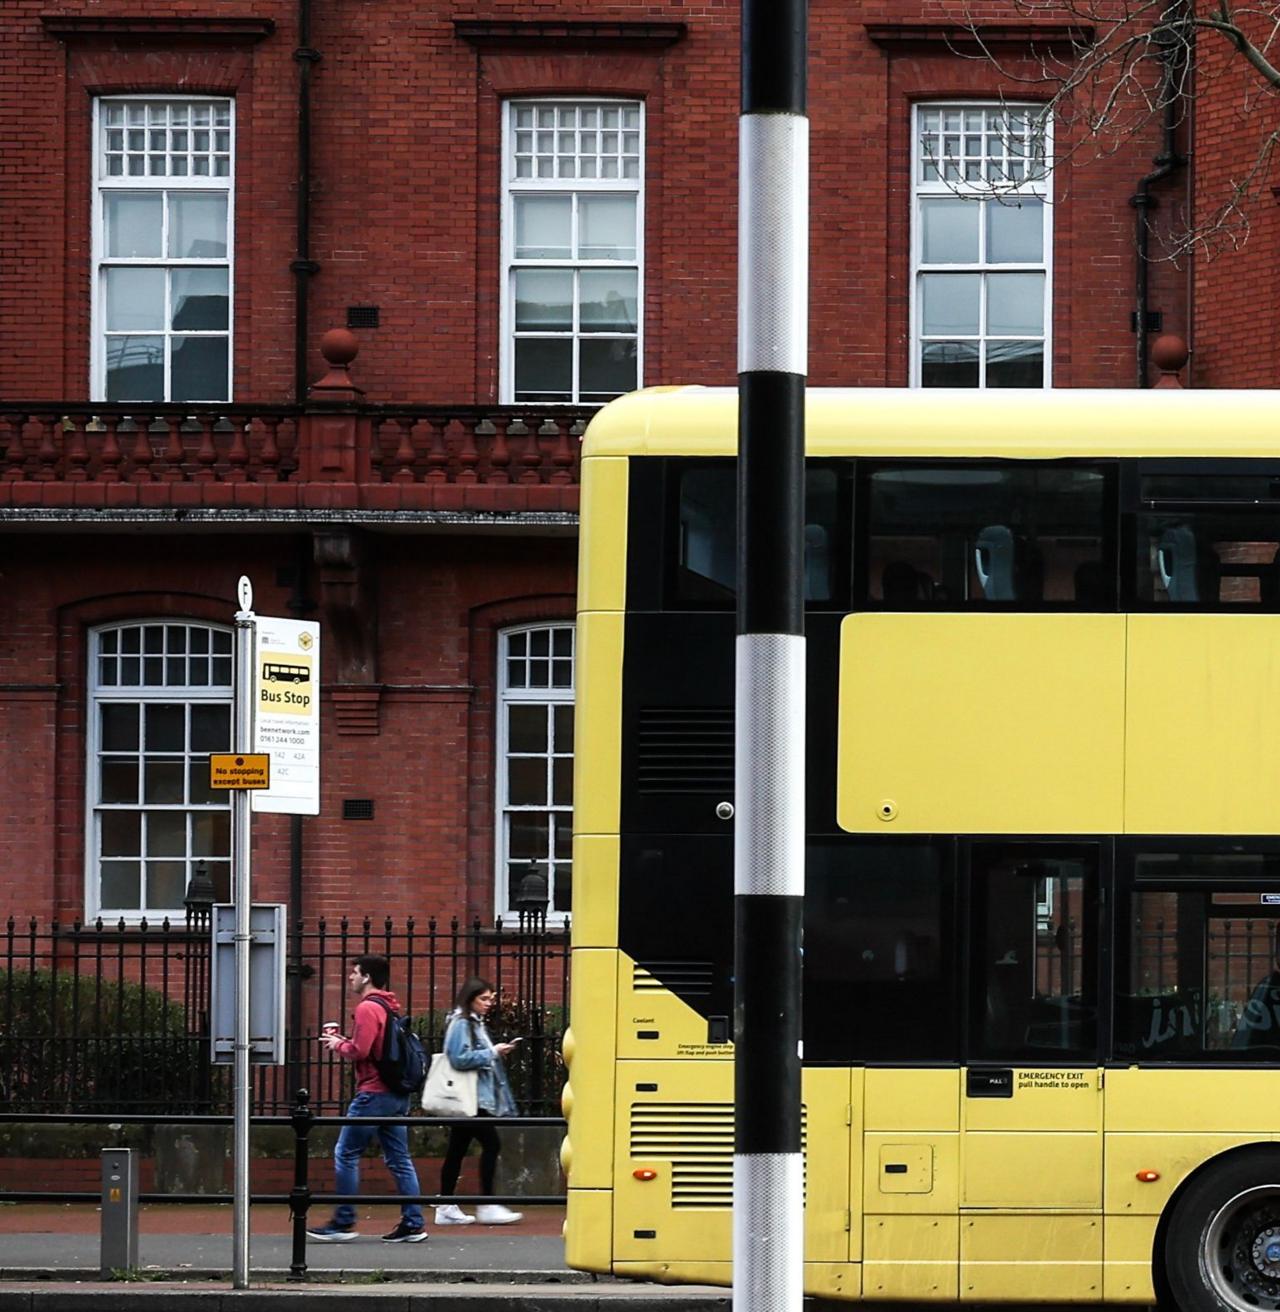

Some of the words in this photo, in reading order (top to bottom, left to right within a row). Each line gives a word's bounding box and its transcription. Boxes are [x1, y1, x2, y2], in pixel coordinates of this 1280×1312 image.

[243, 583, 248, 604] F
[261, 689, 281, 703] Bus
[283, 691, 310, 707] Stop
[260, 726, 310, 735] beenetwork.com
[230, 768, 264, 776] stopping
[1019, 1072, 1065, 1080] EMERGENCY
[1067, 1072, 1084, 1080] EXIT
[1019, 1081, 1033, 1089] pull
